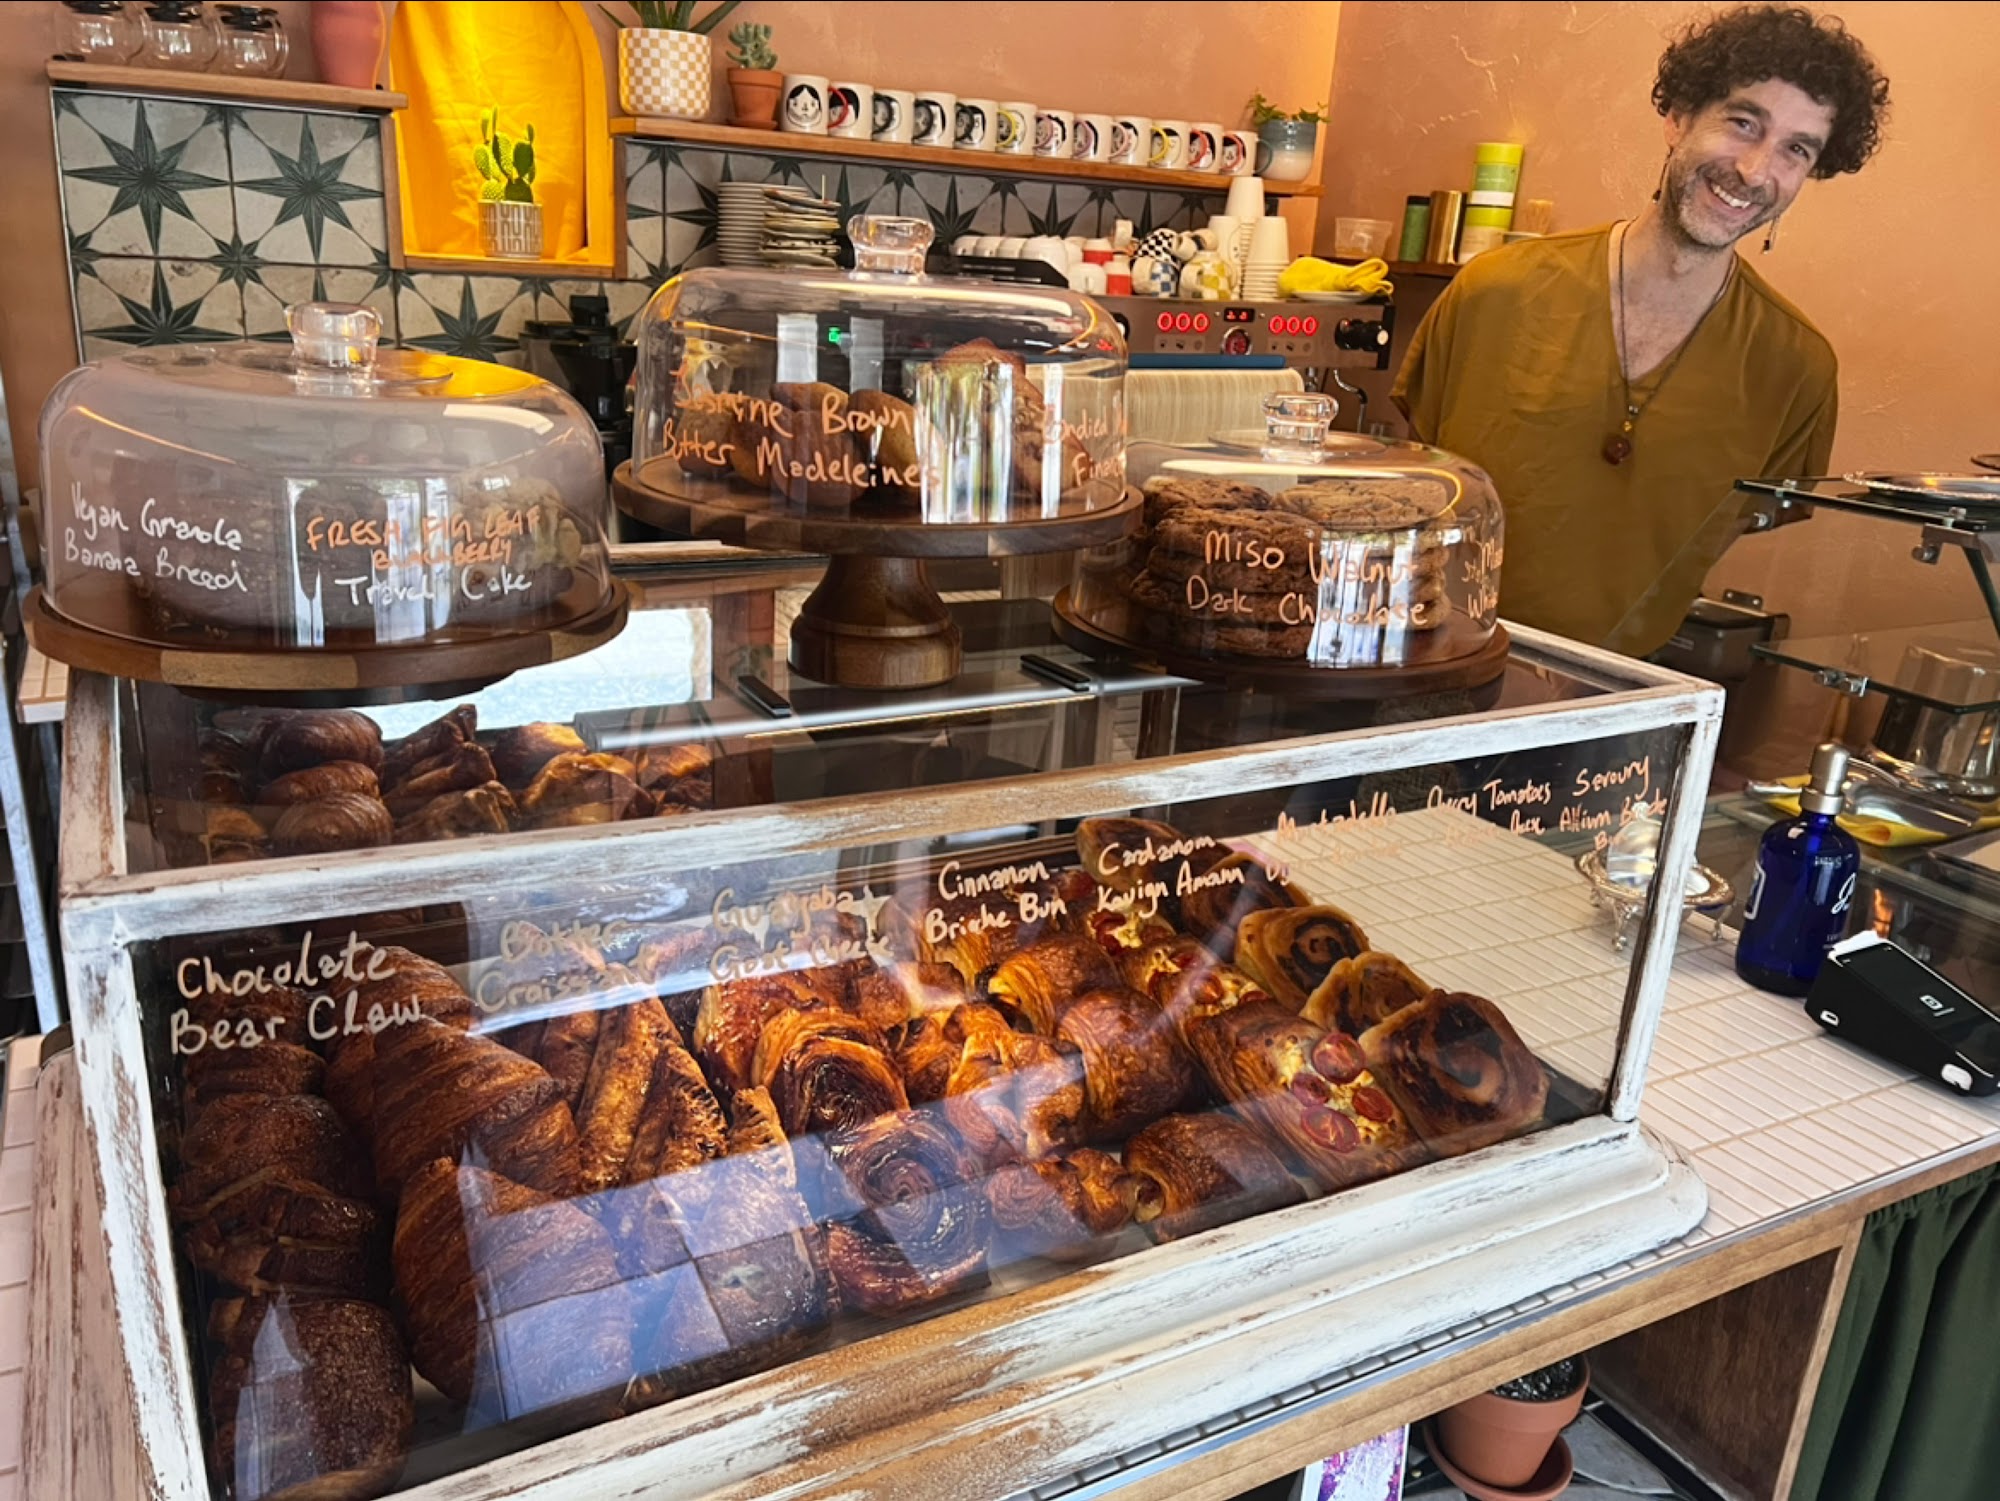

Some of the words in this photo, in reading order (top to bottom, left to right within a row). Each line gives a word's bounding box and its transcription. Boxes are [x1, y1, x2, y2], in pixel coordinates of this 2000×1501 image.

[821, 391, 912, 435] Brown
[662, 417, 736, 466] Butter
[756, 435, 943, 488] Madeleines
[70, 480, 130, 541] Vegan
[140, 498, 243, 551] Granola
[306, 516, 403, 551] FRESH
[422, 513, 472, 543] FIG
[484, 505, 541, 540] LEAF
[64, 526, 142, 576] Banana
[154, 545, 248, 593] Bread
[1205, 530, 1286, 570] Miso
[1308, 542, 1419, 585] Walnut
[334, 574, 436, 606] Travel
[460, 565, 533, 601] Cake
[1186, 574, 1254, 614] Dark
[1278, 591, 1429, 626] Chocolate
[1482, 778, 1551, 811] Tomatoes
[937, 860, 1052, 901] Cinnamon
[1096, 878, 1169, 919] Kouign
[1175, 859, 1246, 897] Amann
[925, 903, 1012, 944] Brioche
[1019, 892, 1068, 924] Bun
[176, 929, 396, 1000] Chocolate
[711, 935, 790, 982] Goat
[169, 1007, 287, 1055] Bear
[307, 989, 422, 1042] Claw
